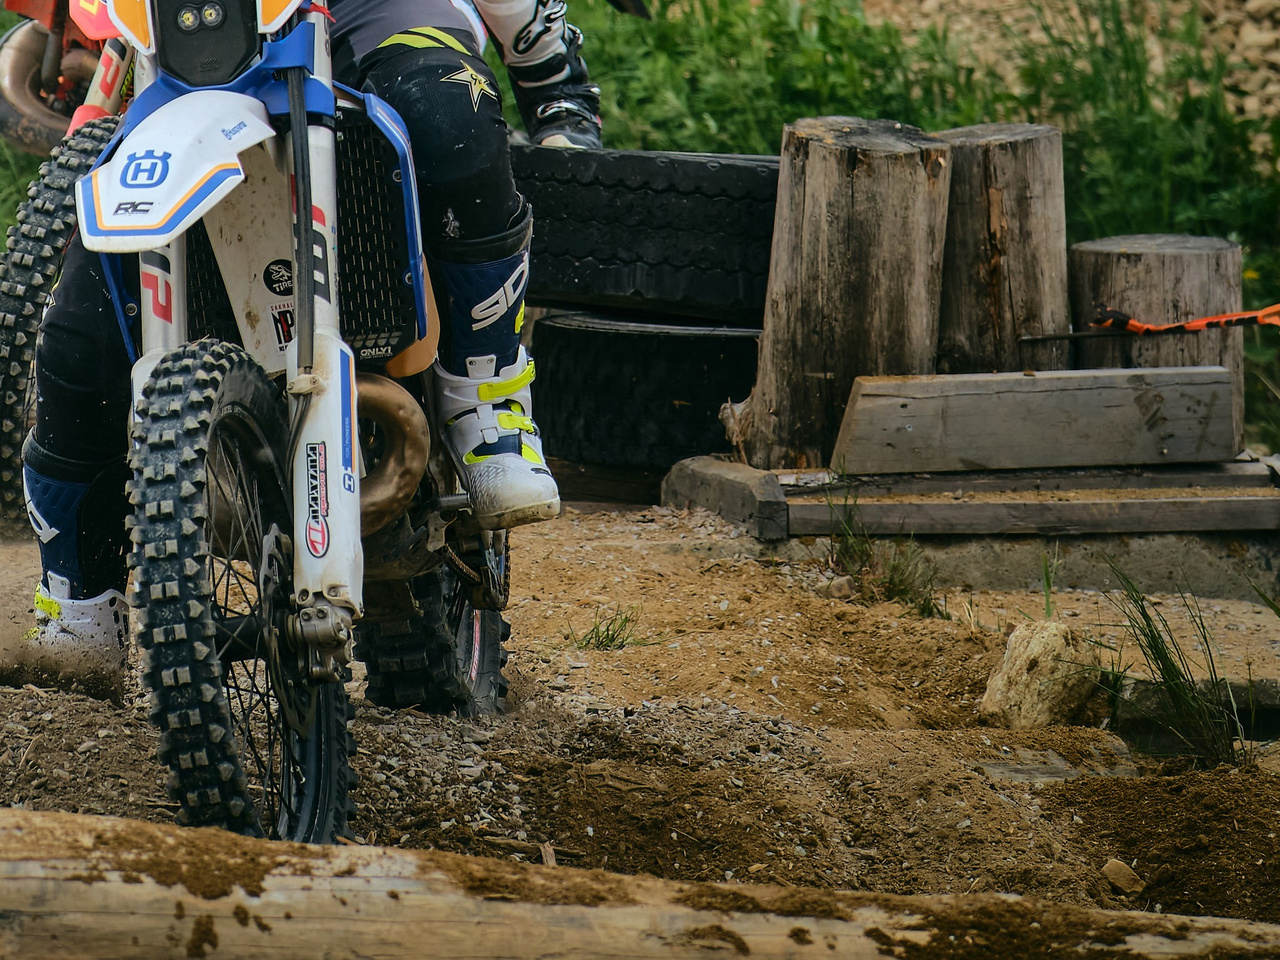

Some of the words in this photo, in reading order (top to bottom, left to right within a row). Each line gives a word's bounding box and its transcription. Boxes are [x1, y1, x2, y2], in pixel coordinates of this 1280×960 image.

[113, 201, 154, 215] RC
[272, 281, 293, 292] TIRE
[360, 345, 392, 357] ONLY1
